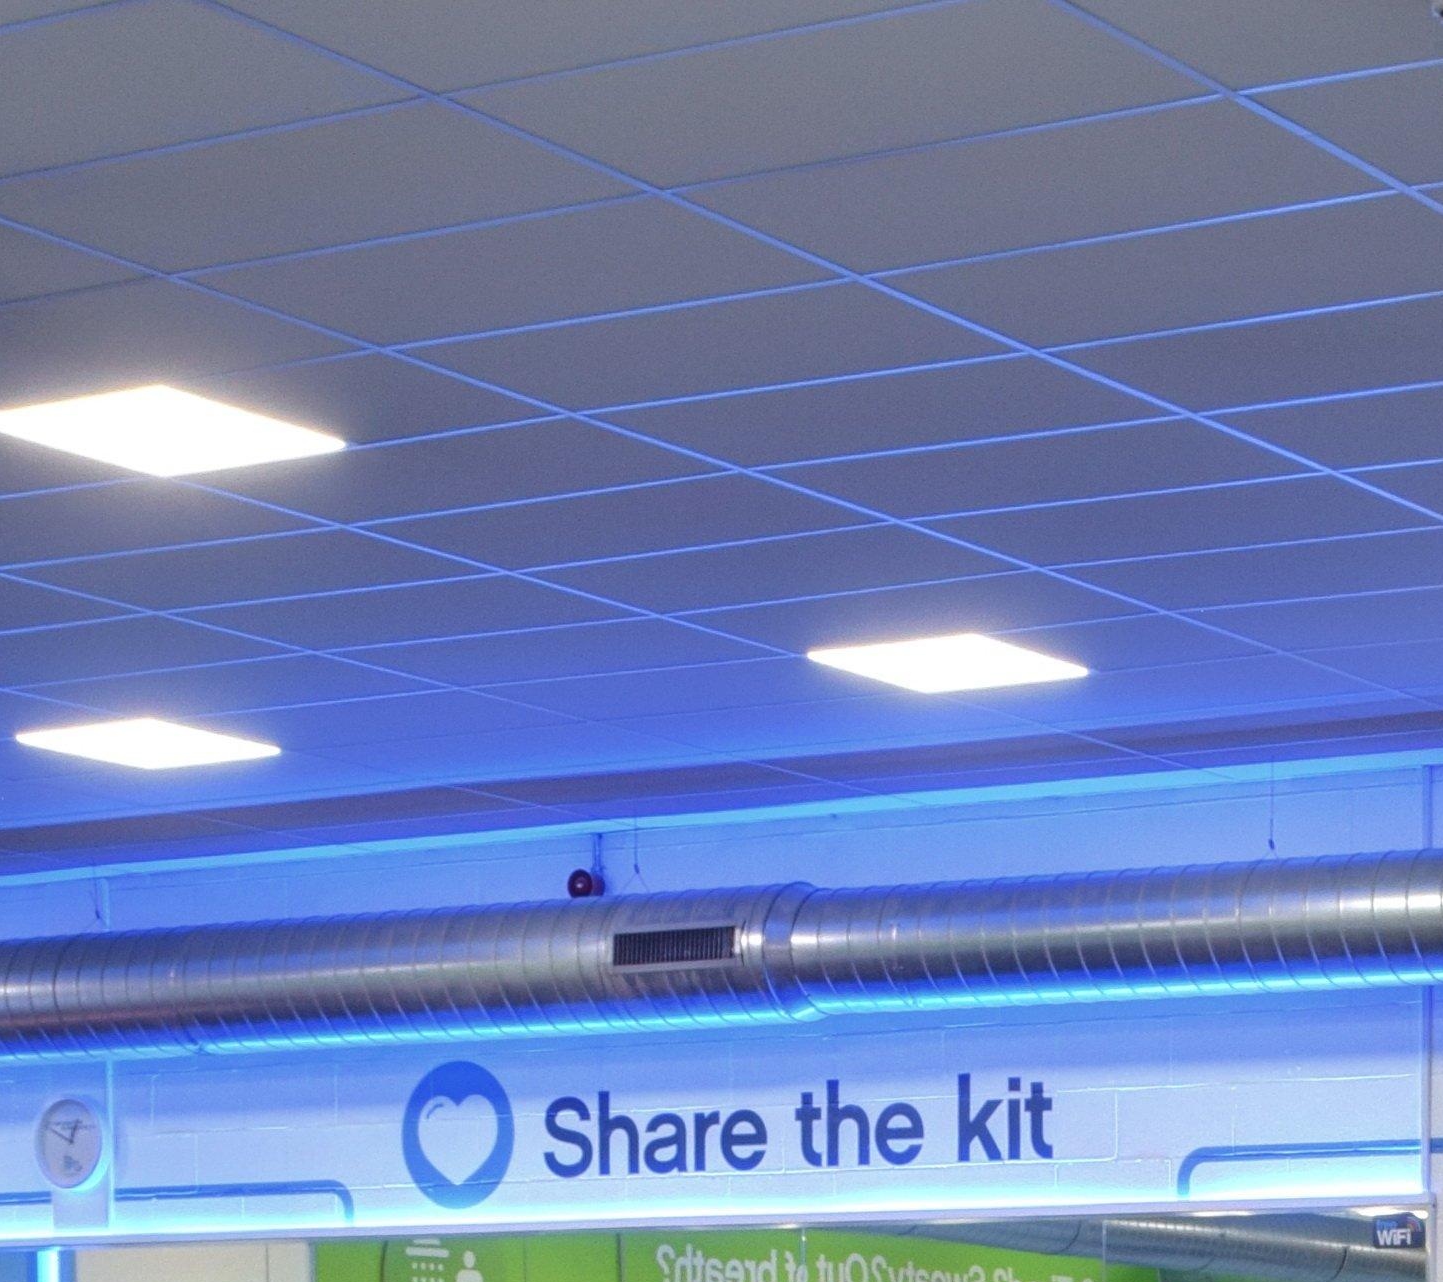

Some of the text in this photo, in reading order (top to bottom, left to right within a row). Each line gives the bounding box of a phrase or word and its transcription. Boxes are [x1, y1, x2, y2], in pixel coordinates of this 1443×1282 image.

[543, 1073, 1054, 1178] Share the kit
